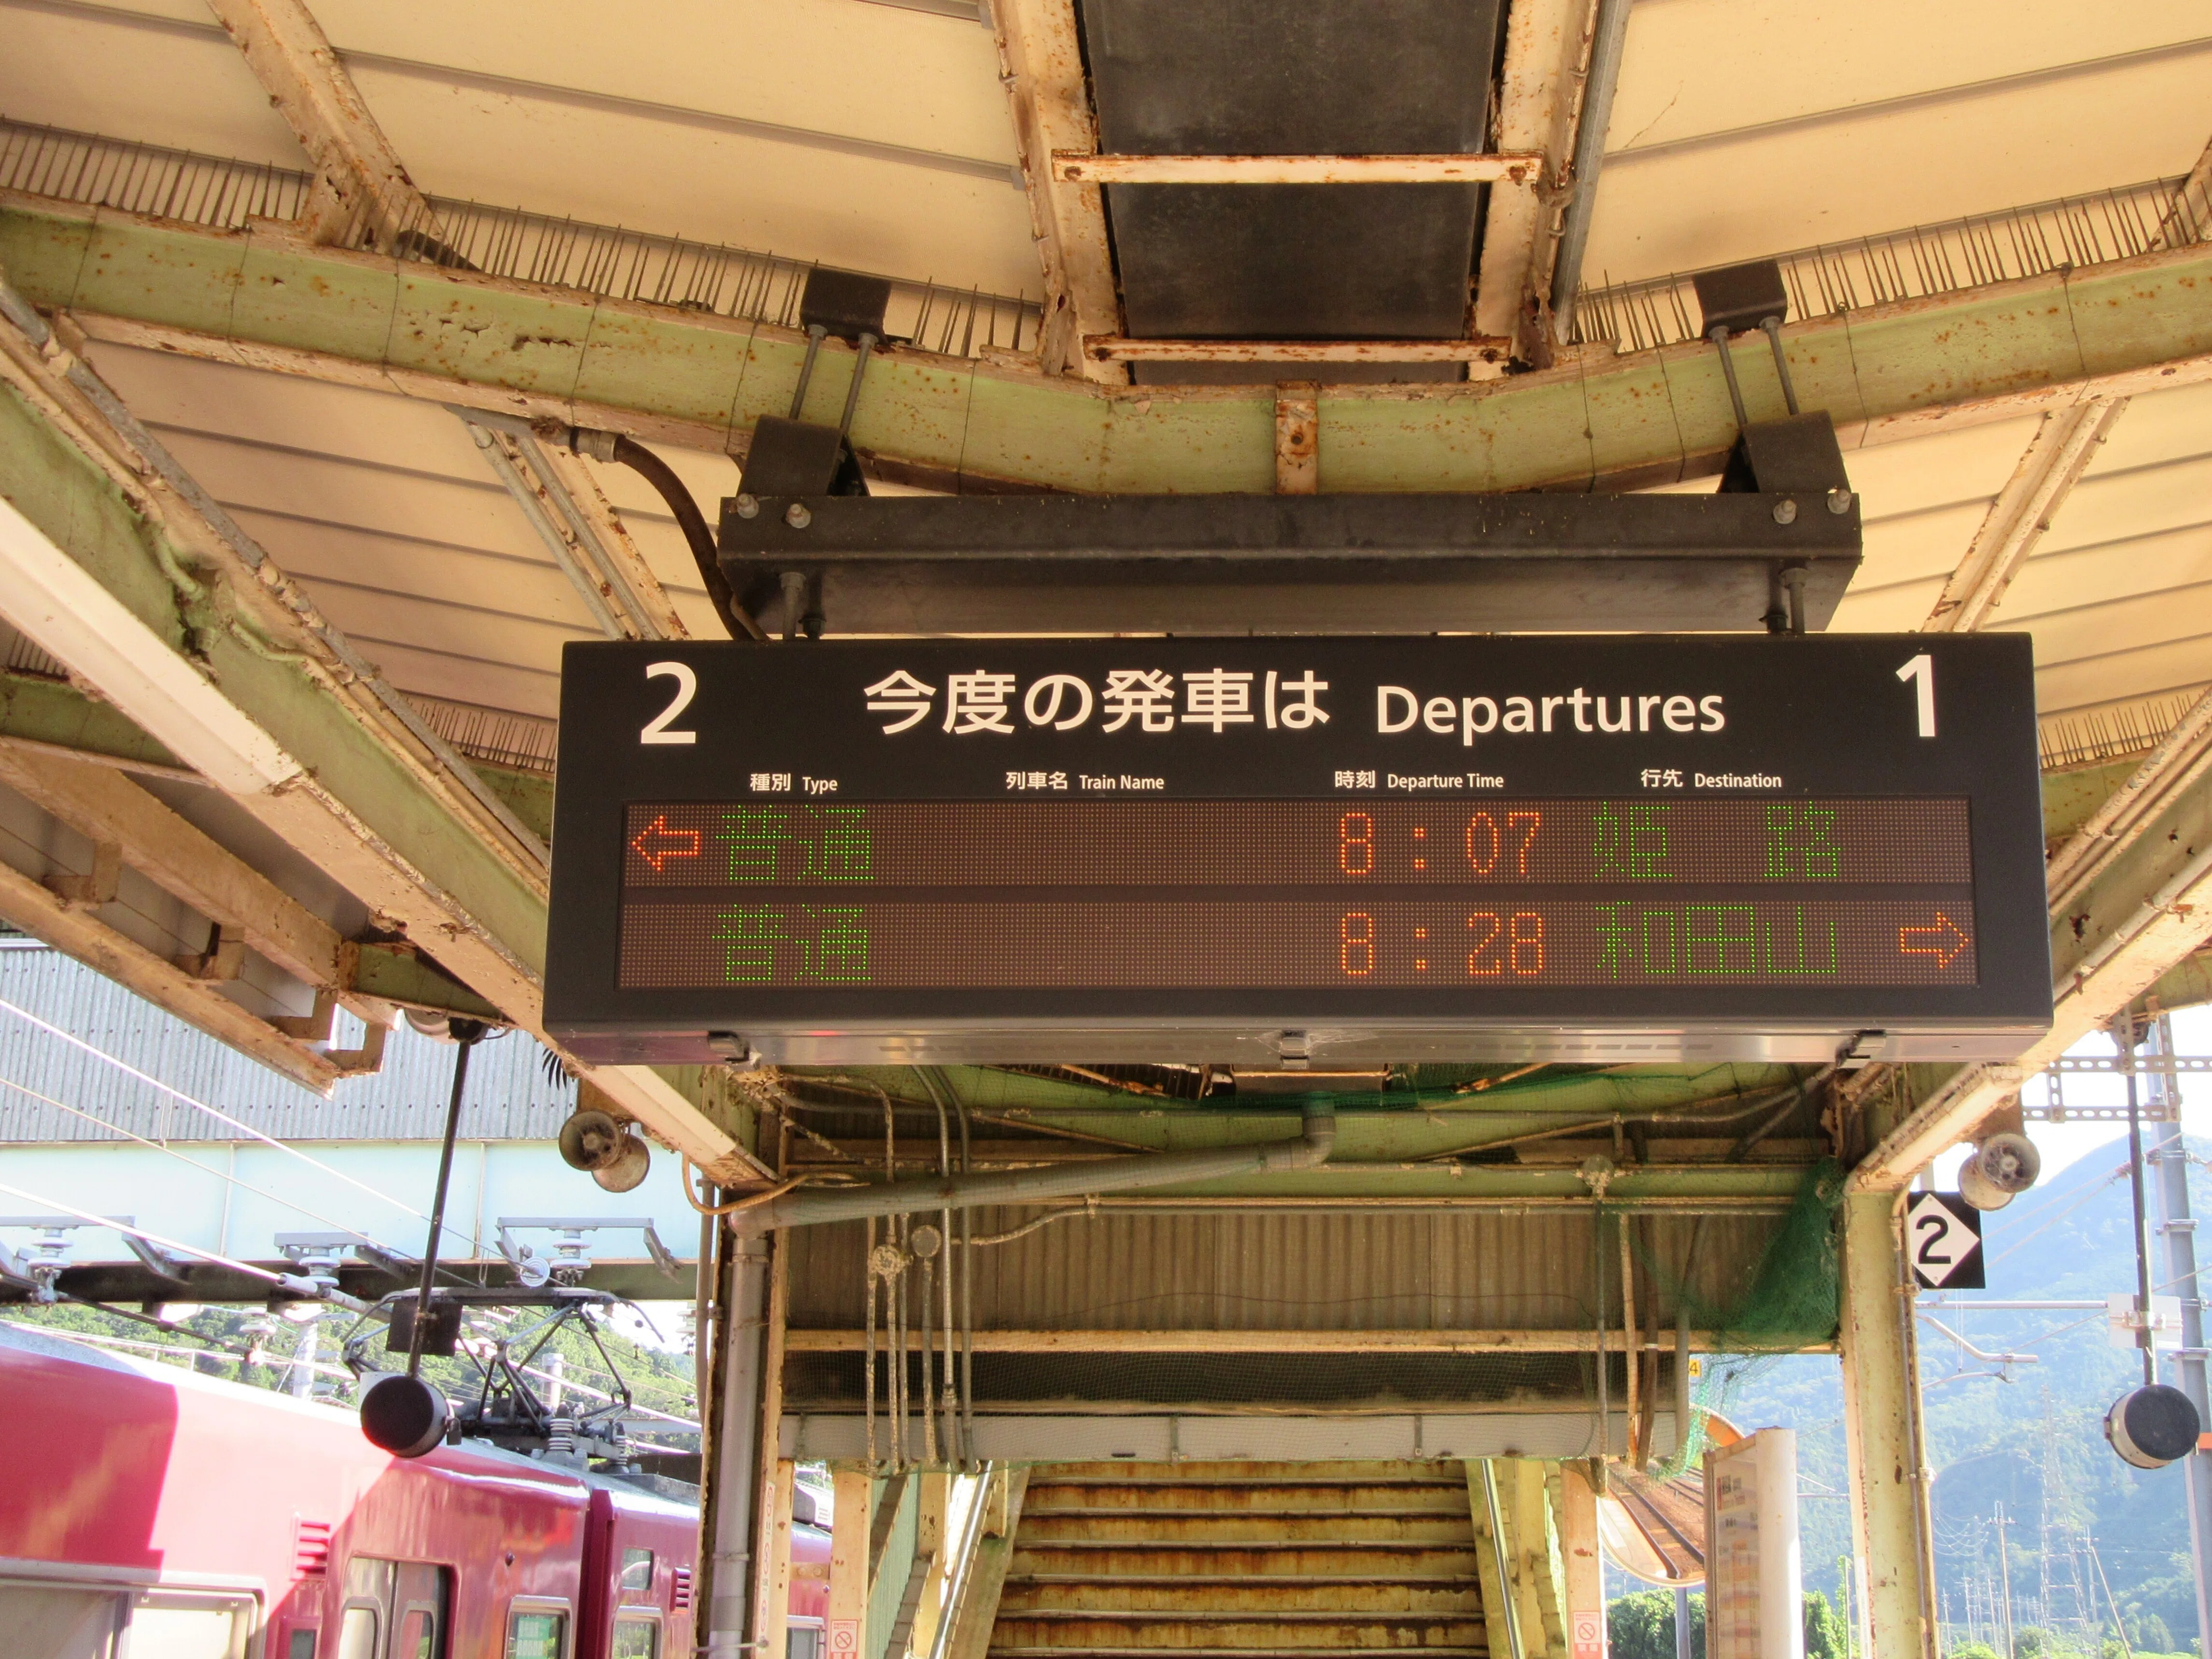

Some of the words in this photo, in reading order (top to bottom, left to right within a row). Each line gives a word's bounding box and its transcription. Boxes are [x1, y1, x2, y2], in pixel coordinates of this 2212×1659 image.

[641, 661, 696, 744] 2
[863, 668, 1330, 734] 今度の発車は
[1377, 686, 1725, 746] Departures
[1895, 655, 1936, 738] 1
[749, 772, 791, 792] 種別
[802, 776, 838, 795] Type
[1005, 771, 1069, 790] 列車名
[1078, 773, 1116, 790] Train
[1120, 774, 1165, 790] Name
[1334, 770, 1377, 789] 時刻
[1387, 773, 1464, 792] Departure
[1466, 773, 1505, 788] Time
[1640, 768, 1684, 788] 行先
[1694, 772, 1783, 788] Destination
[716, 804, 875, 880] 普通
[712, 903, 872, 981] 普通
[1595, 901, 1836, 979] 和田山
[1916, 1214, 1951, 1264] 2
